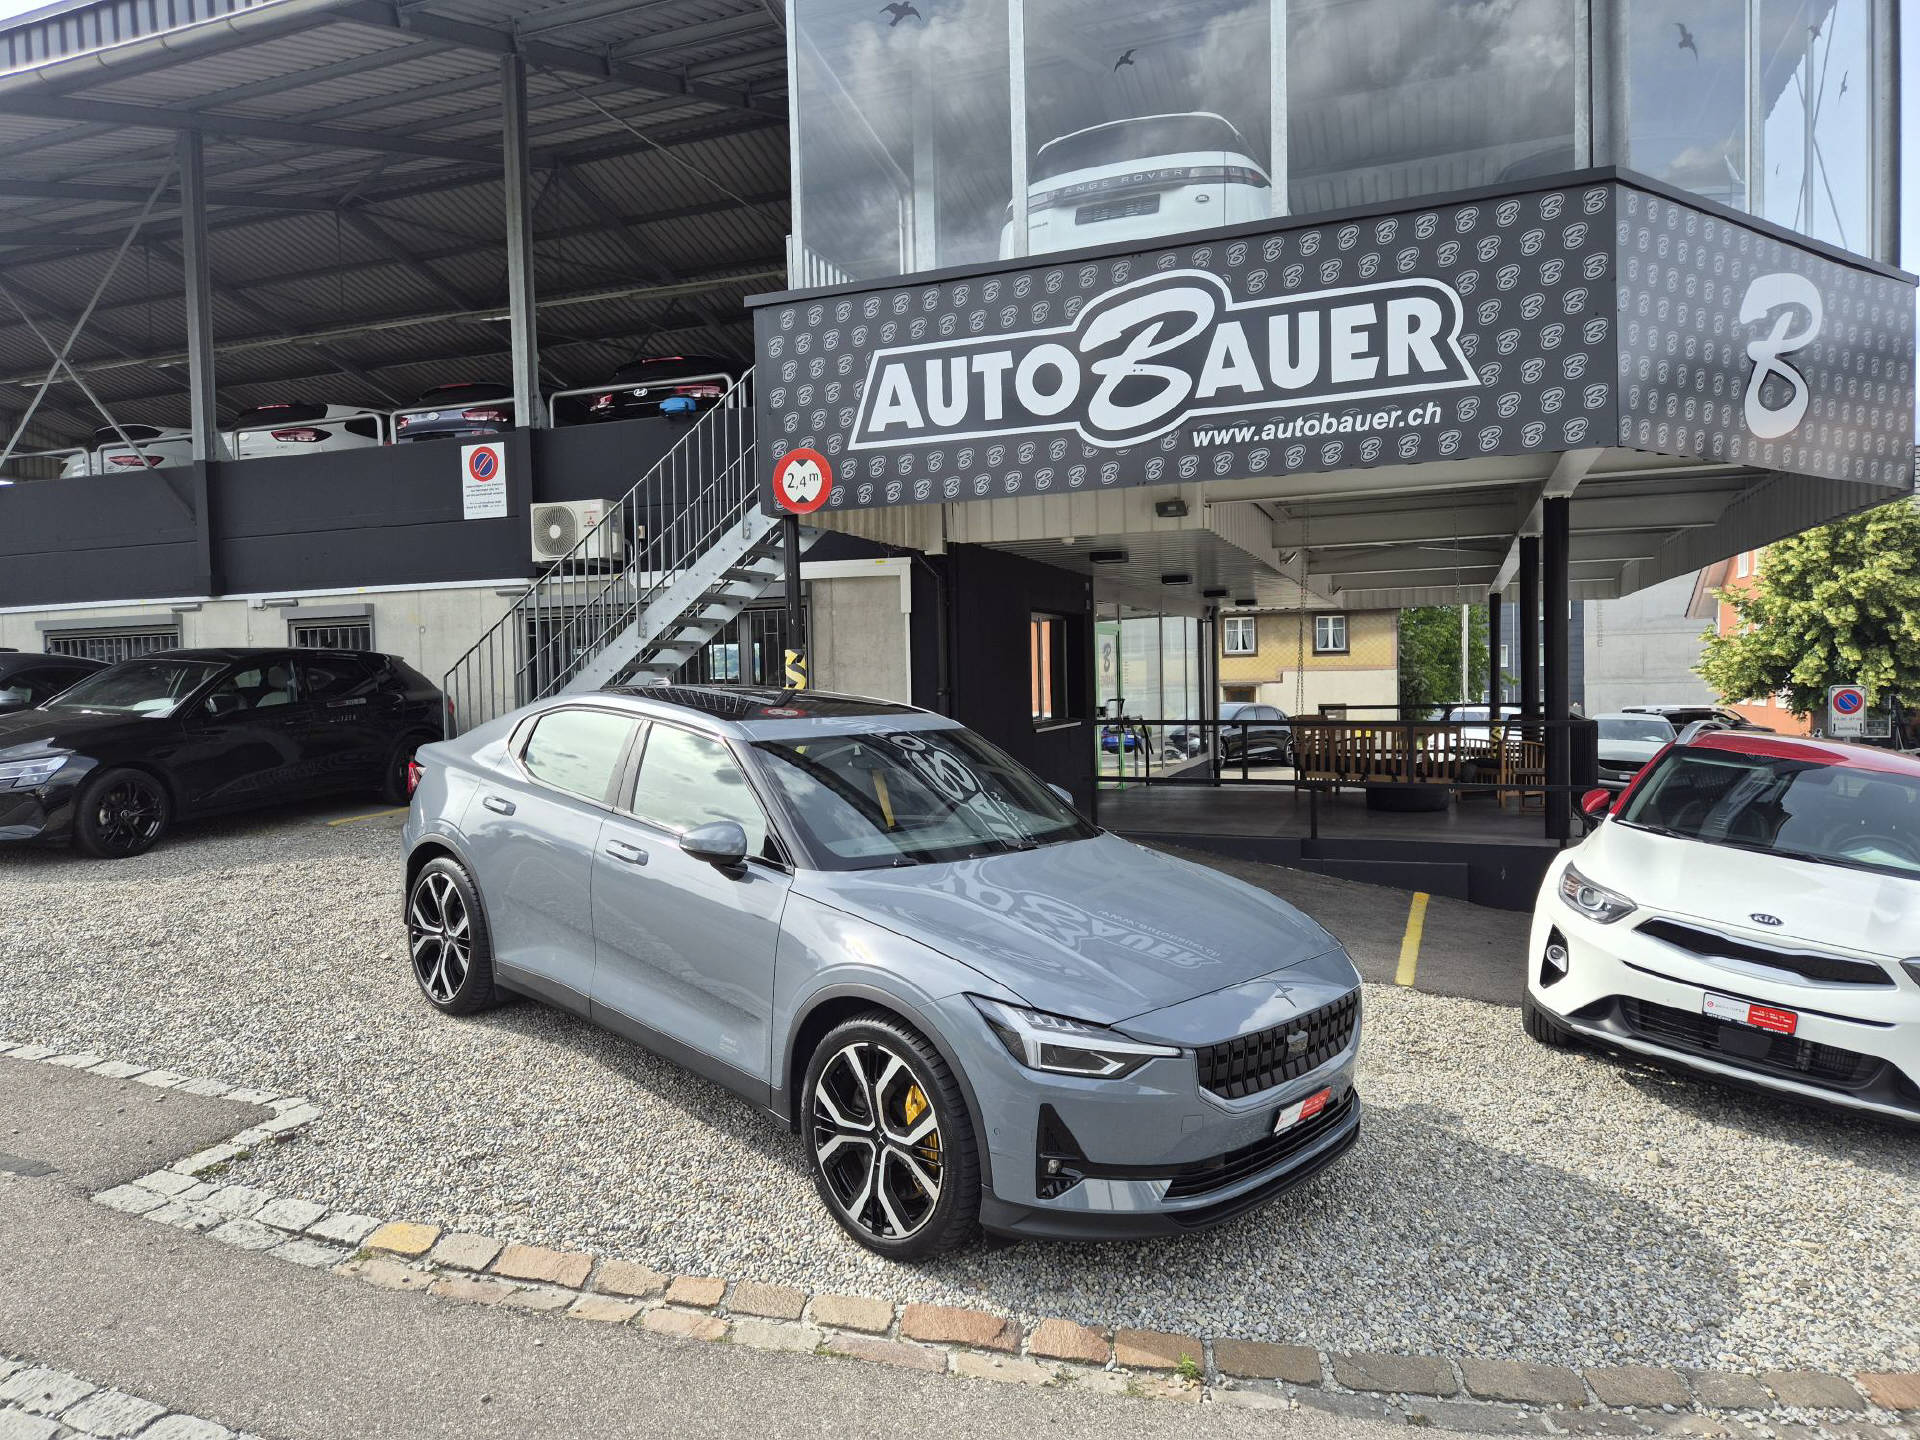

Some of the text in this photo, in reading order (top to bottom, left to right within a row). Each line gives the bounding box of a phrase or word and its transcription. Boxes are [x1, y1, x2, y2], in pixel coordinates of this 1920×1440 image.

[1050, 169, 1186, 200] RANGE ROVER
[1192, 402, 1442, 447] www.autobauer.ch
[1752, 914, 1780, 925] KIA
